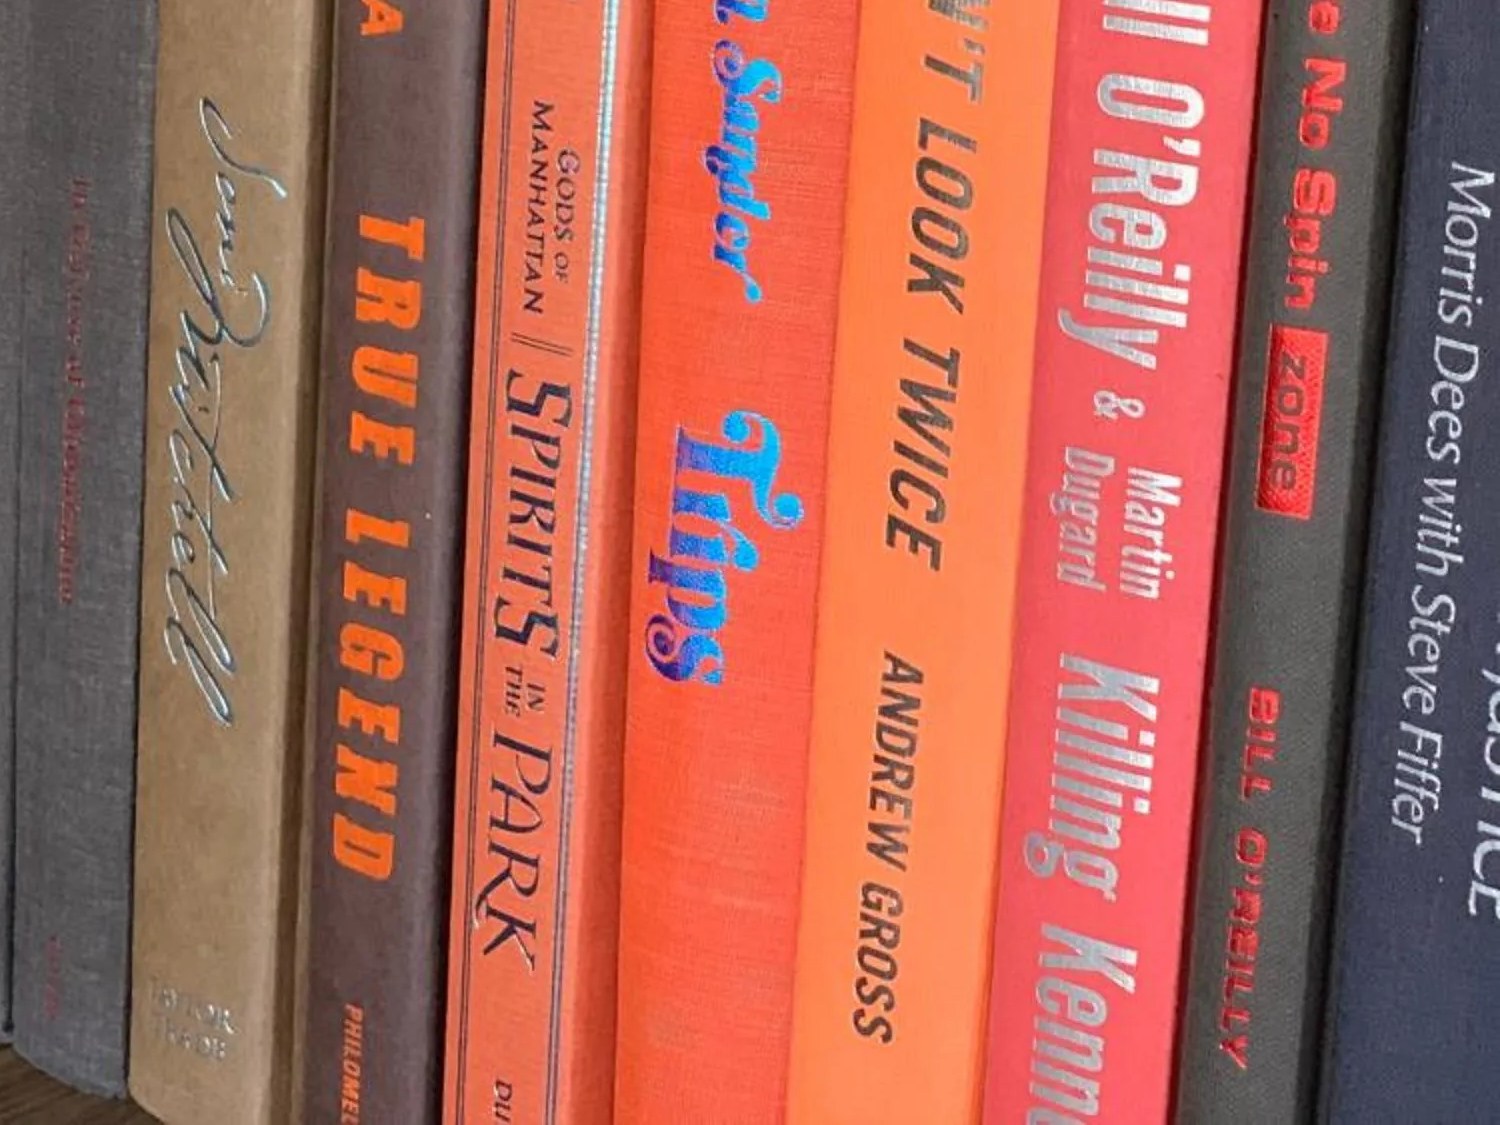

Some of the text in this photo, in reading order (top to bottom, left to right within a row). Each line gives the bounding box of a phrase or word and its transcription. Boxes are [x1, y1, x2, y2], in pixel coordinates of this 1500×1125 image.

[522, 100, 554, 315] MANHATTAN
[1299, 56, 1348, 151] No
[553, 148, 580, 284] GODS OF
[907, 118, 979, 316] LOOK
[1057, 72, 1206, 372] O'Reilly
[1283, 167, 1337, 312] Spin
[64, 356, 85, 388] of
[165, 96, 288, 727] Joni Mitchell
[885, 337, 961, 573] TWICE
[1093, 389, 1146, 422] &
[1266, 352, 1308, 493] zone
[332, 214, 426, 882] TRUE LEGEND
[644, 409, 805, 686] Trips
[1049, 446, 1117, 595] Dugard
[1118, 465, 1185, 601] Martin
[1391, 159, 1496, 846] Morris Dees with Steve Fiffer
[472, 369, 573, 972] SPIRITS IN THE PARK
[1023, 652, 1161, 904] Killing
[852, 649, 925, 1046] ANDREW GROSS
[1218, 685, 1281, 1071] BILL O'REILLY
[340, 1002, 363, 1125] PHILOMEL
